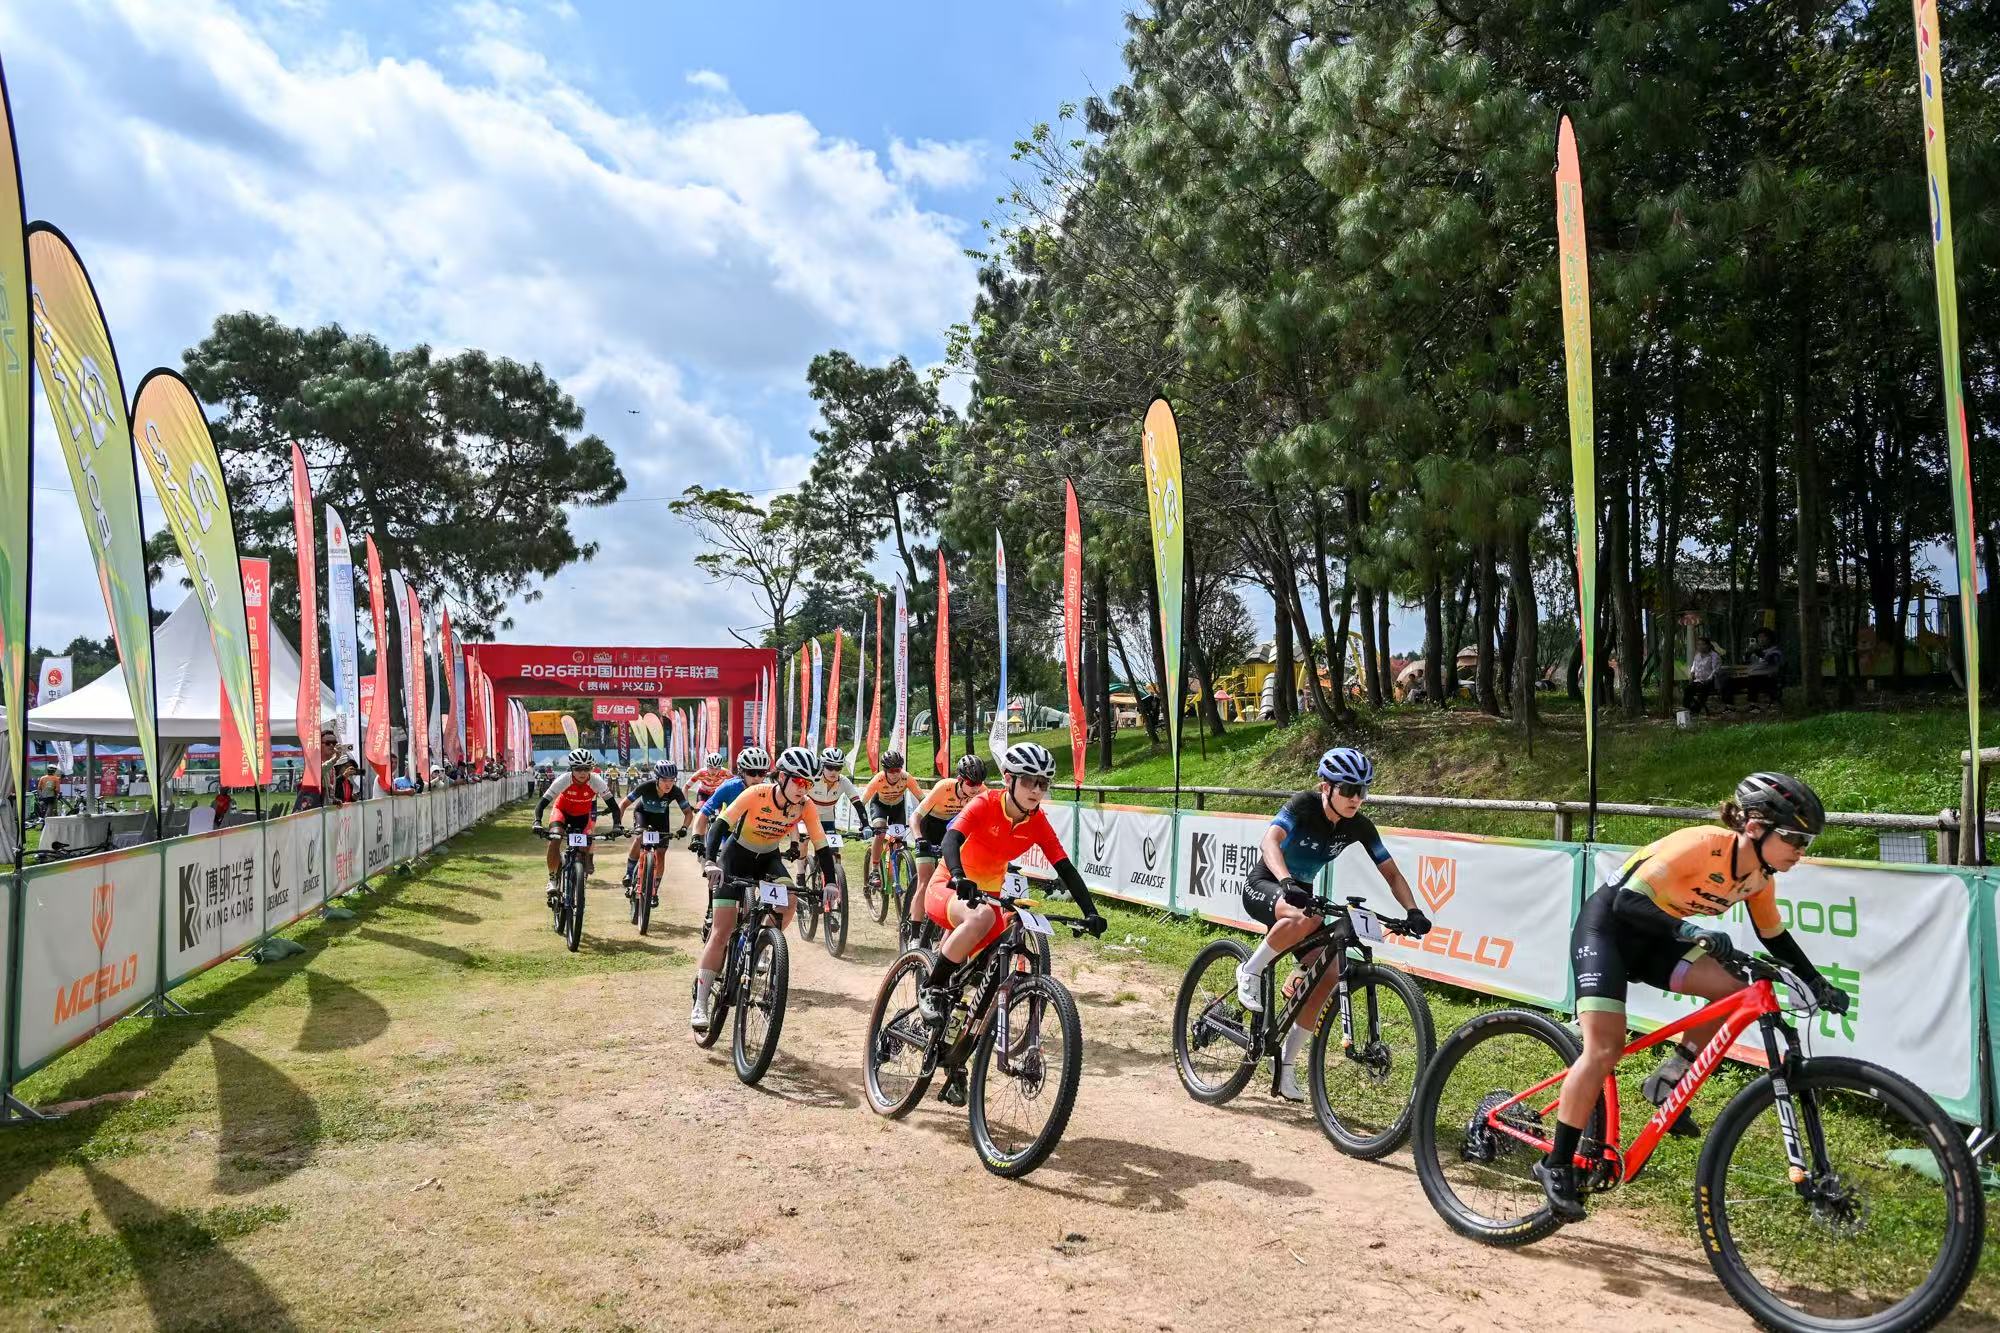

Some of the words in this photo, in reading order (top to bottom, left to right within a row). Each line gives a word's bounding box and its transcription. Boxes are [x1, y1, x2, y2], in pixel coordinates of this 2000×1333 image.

[520, 664, 719, 679] 2026年中国山地自行车联赛
[574, 835, 582, 844] 12
[1221, 843, 1258, 877] 博纳
[205, 856, 254, 908] 博纳光学
[1014, 878, 1022, 893] 5
[1131, 871, 1166, 889] DELAISSE
[1220, 879, 1242, 895] KIN
[769, 887, 779, 900] 4
[206, 907, 228, 929] KING
[230, 896, 254, 920] KONG
[1359, 915, 1369, 934] 7
[1275, 948, 1328, 1034] SCOTT
[1650, 1023, 1734, 1134] SPECIALIZED
[1700, 1186, 1721, 1252] MAXXIS
